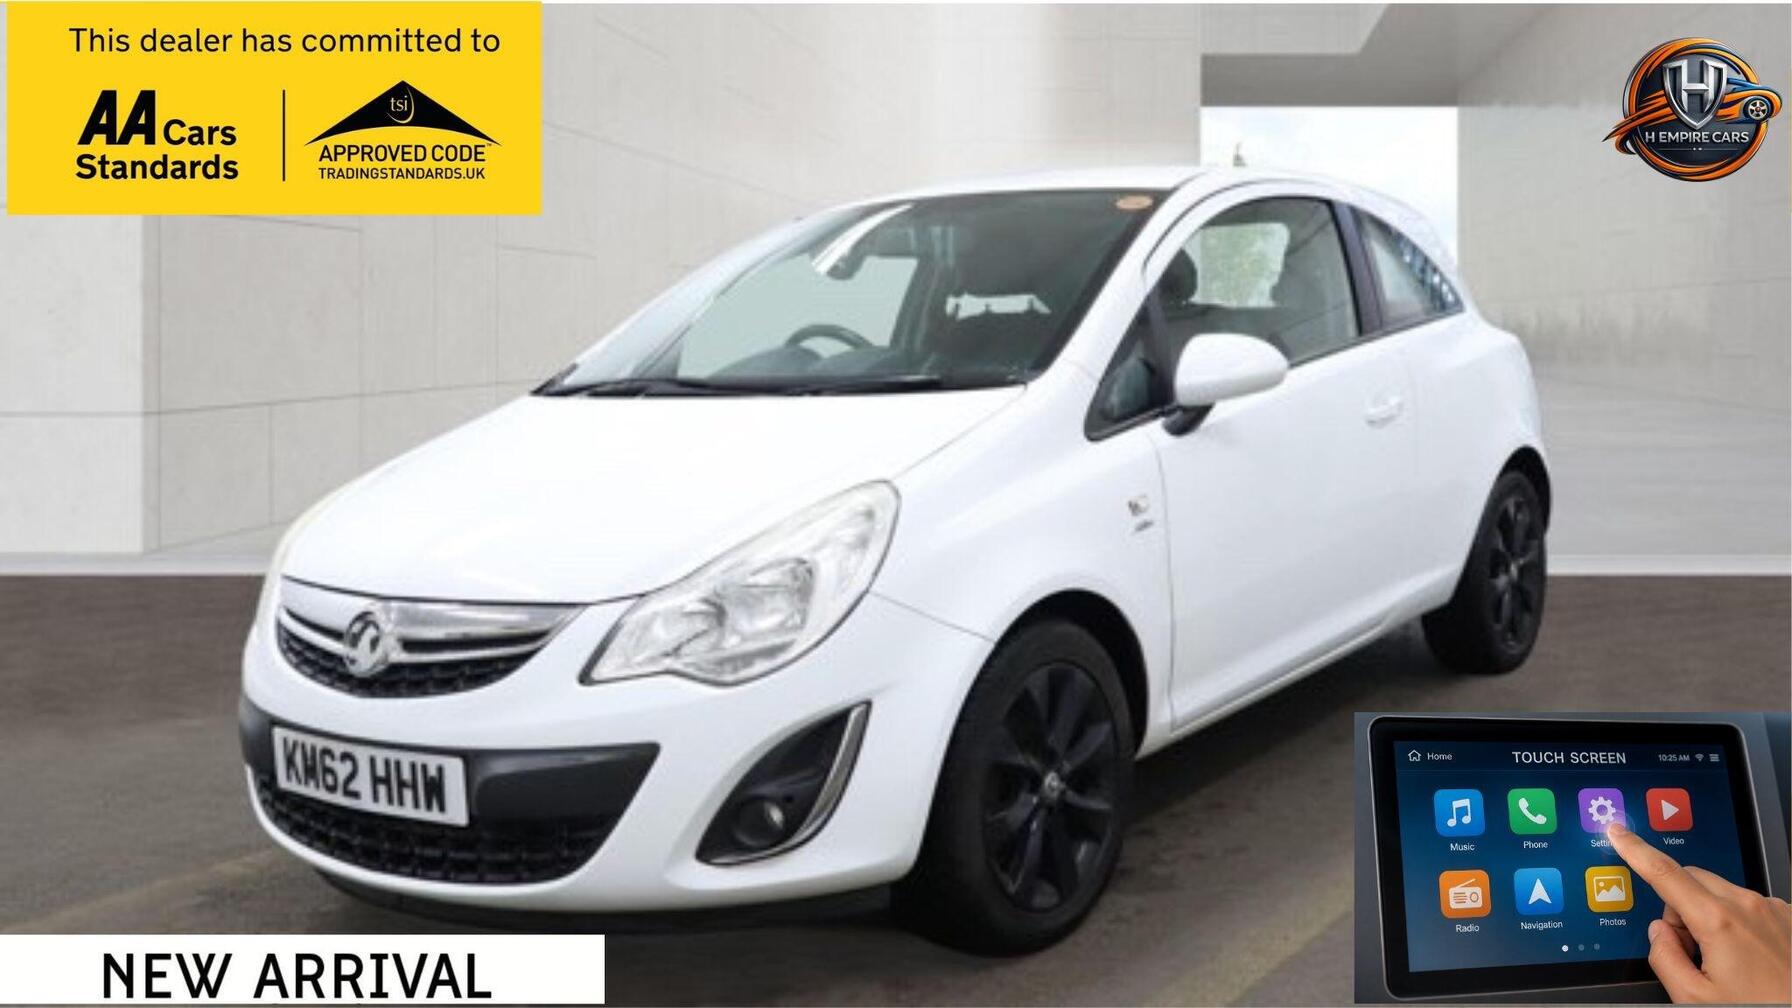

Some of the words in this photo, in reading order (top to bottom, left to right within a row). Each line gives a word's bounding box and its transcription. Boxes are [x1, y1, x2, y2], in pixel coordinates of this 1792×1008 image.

[1427, 752, 1453, 761] Home
[1511, 751, 1565, 764] TOUCH
[1570, 751, 1627, 764] SCREEN
[1658, 753, 1678, 762] 10:25
[1678, 754, 1691, 762] AM
[283, 737, 360, 800] KM62
[369, 755, 445, 813] HHW
[1523, 840, 1549, 849] Phone
[1590, 839, 1614, 848] Settin
[1662, 836, 1685, 846] Video
[1450, 842, 1475, 852] Music
[1520, 920, 1564, 931] Navigation
[1599, 917, 1627, 926] Photos
[1455, 923, 1480, 933] Radio
